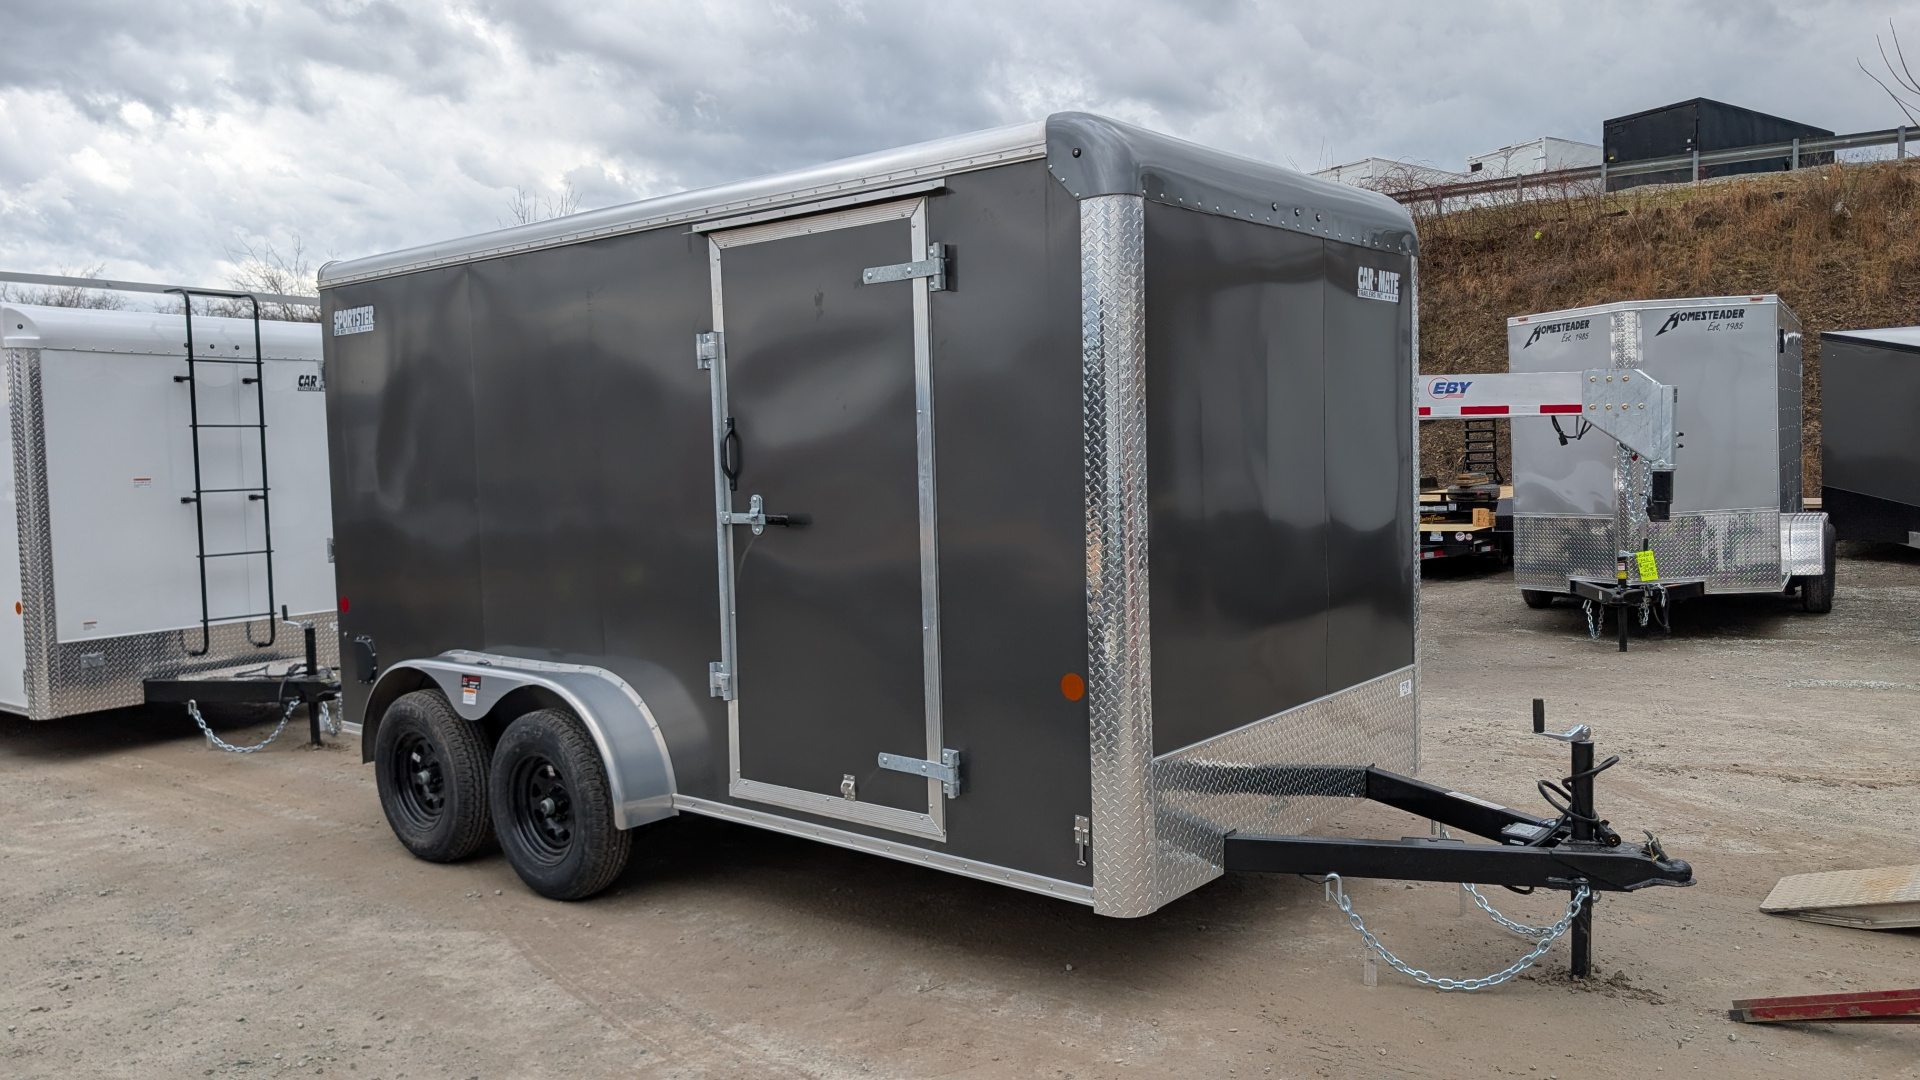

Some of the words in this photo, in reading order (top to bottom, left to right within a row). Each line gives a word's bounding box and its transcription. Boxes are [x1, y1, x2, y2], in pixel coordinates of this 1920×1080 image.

[1358, 266, 1374, 291] CAR
[1378, 270, 1399, 295] MATE
[334, 305, 374, 329] SPORTSTER
[1654, 309, 1745, 337] HOMESTEADER
[1707, 321, 1721, 331] Est.
[1725, 322, 1744, 330] 1985
[1523, 320, 1590, 349] HOMESTEADER
[1575, 332, 1589, 341] 1985
[298, 375, 317, 387] CAR
[1433, 382, 1473, 394] EBY
